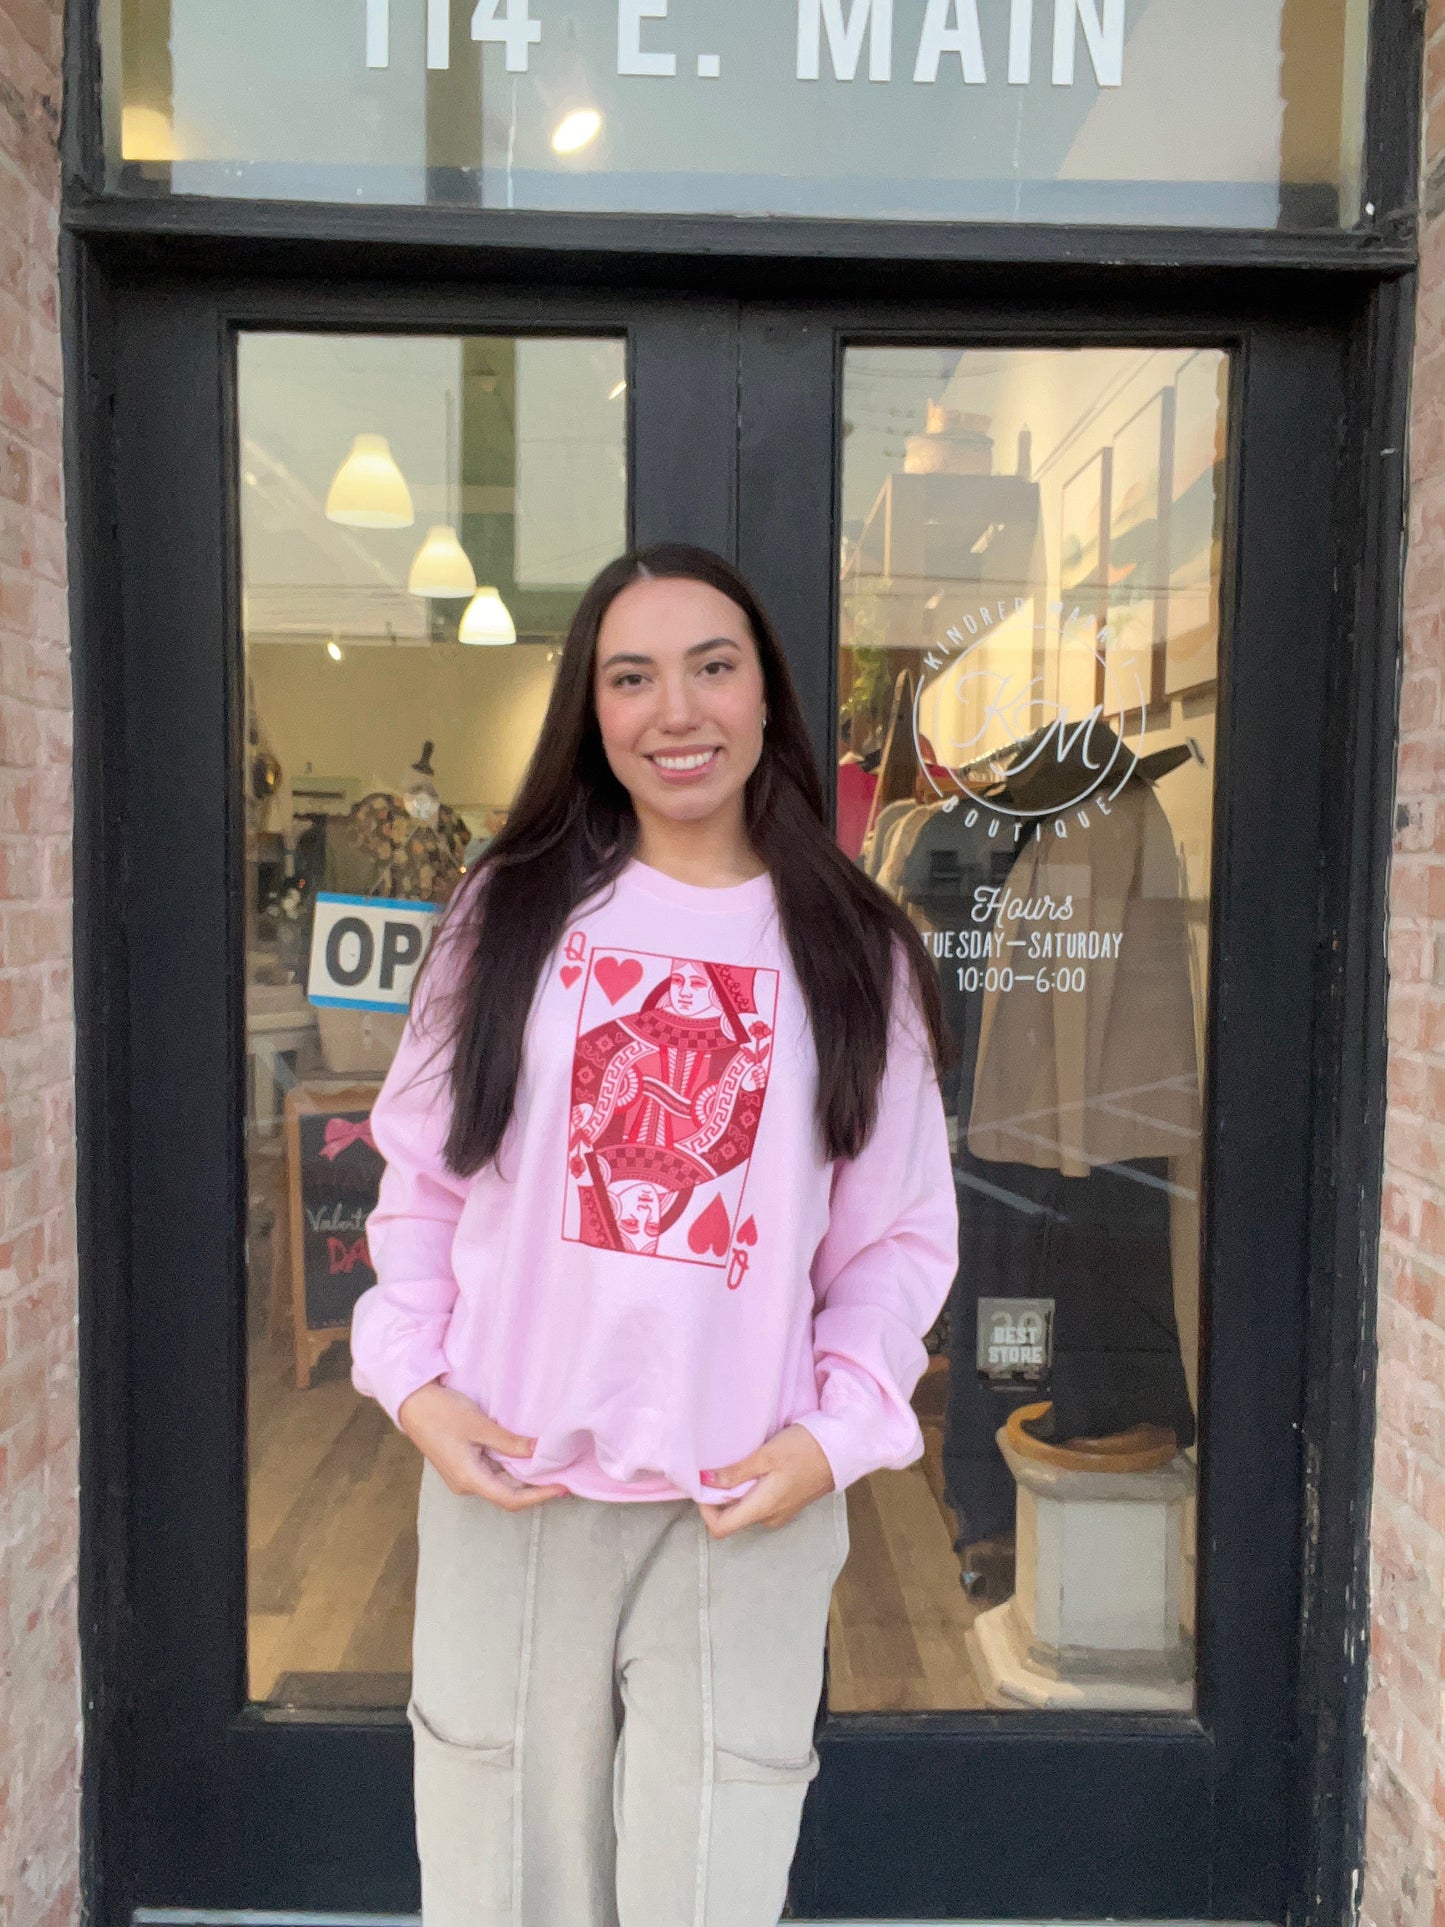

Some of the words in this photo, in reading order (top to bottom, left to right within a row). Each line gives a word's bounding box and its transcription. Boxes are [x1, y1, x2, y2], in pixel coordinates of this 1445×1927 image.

[796, 0, 1126, 86] MAIN
[942, 794, 1112, 842] BOUTIQUE
[970, 885, 1073, 928] Hours
[325, 917, 440, 990] OP
[564, 931, 586, 962] Q
